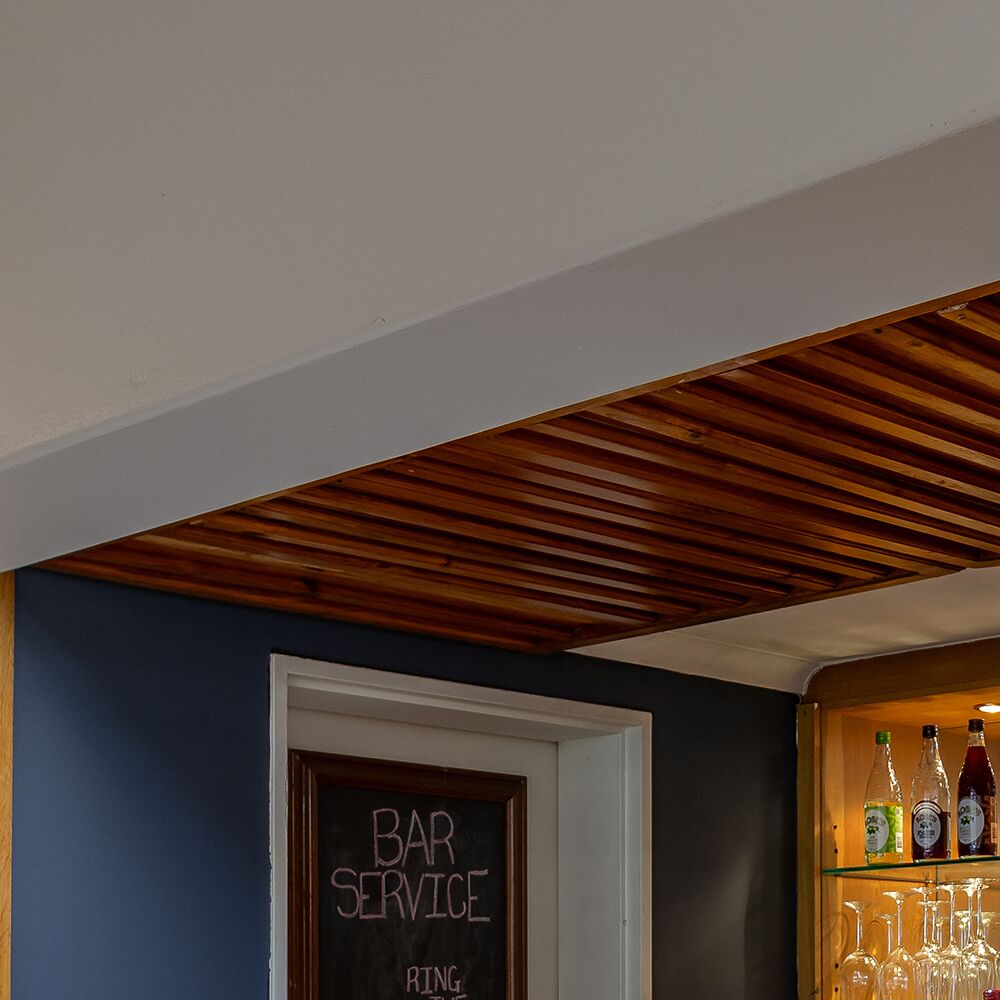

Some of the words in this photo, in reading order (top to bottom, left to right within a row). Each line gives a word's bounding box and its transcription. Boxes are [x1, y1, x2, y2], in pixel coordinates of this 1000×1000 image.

[373, 808, 454, 867] BAR
[331, 866, 490, 922] SERVICE
[406, 965, 460, 995] RING
